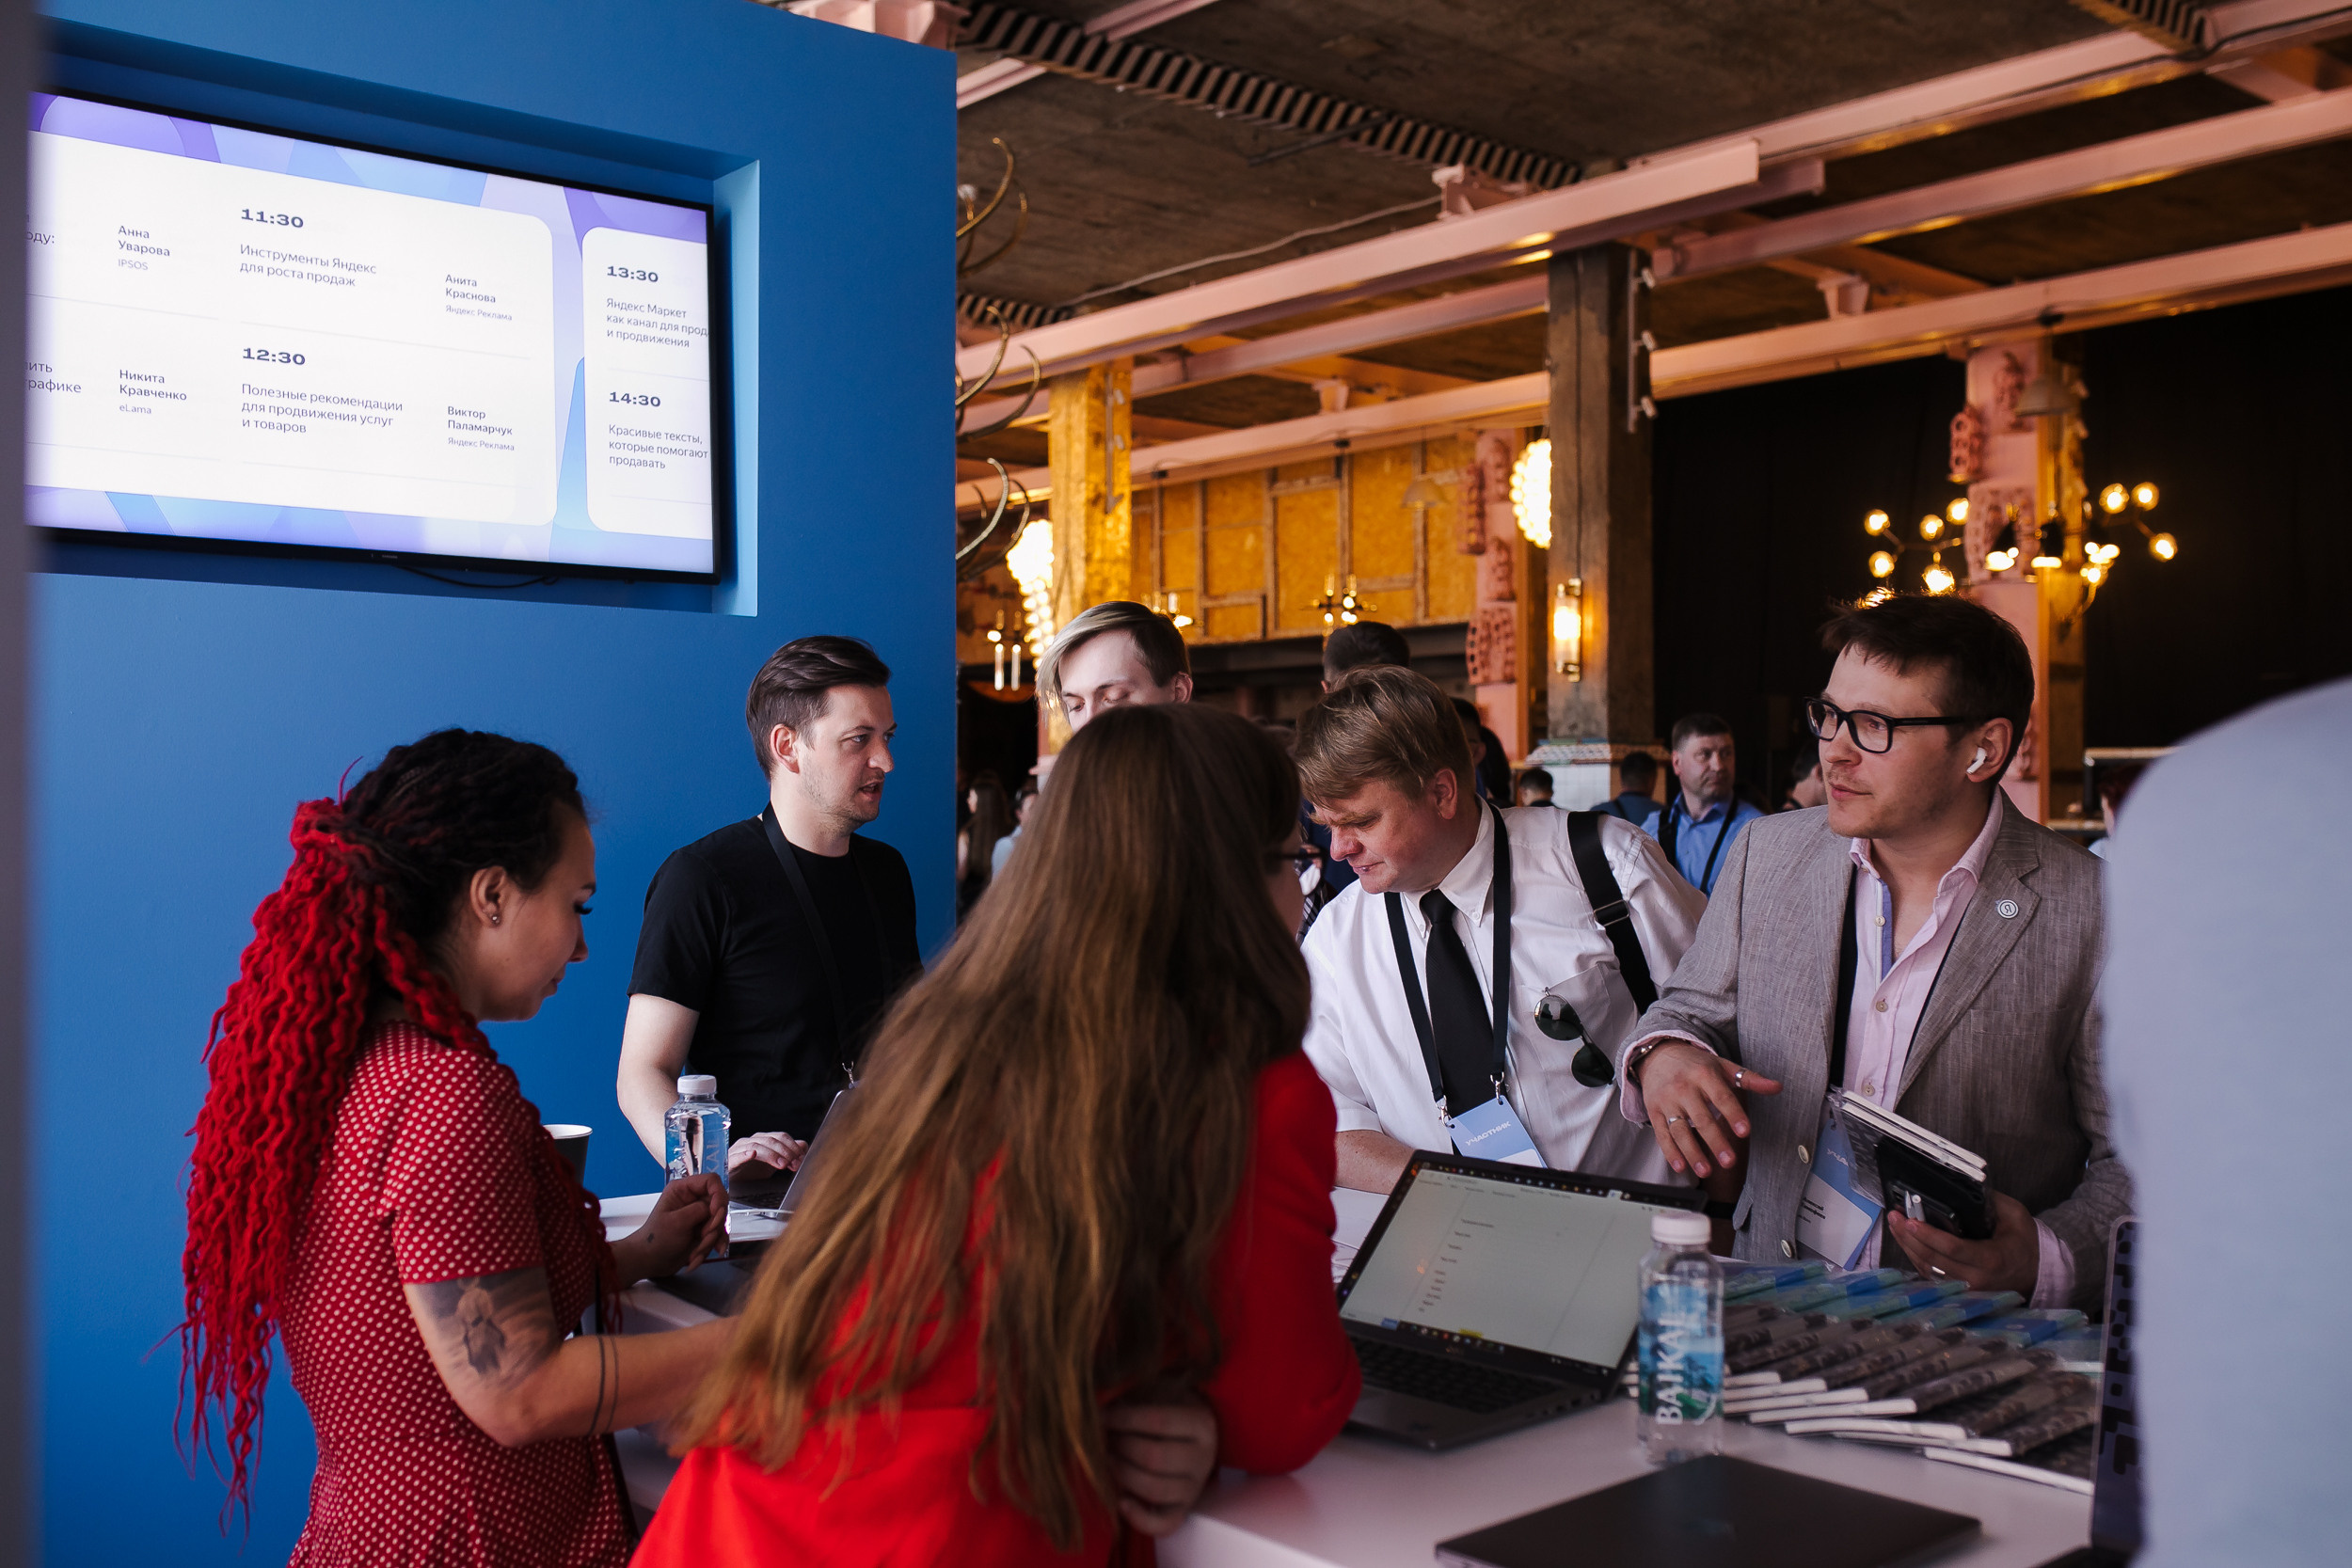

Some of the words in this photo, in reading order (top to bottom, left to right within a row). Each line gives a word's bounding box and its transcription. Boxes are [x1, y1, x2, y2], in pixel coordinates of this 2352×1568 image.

[241, 208, 305, 229] 11:30
[118, 225, 151, 239] Анна
[118, 240, 171, 257] Уварова
[118, 259, 149, 271] IPSOS
[240, 244, 330, 267] Инструменты
[332, 258, 377, 275] Яндекс
[240, 261, 264, 275] для
[267, 266, 304, 280] роста
[307, 271, 356, 286] продаж
[445, 274, 478, 287] Анита
[607, 265, 660, 283] 13:30
[445, 288, 497, 303] Краснова
[445, 305, 476, 318] Яндекс
[477, 309, 513, 322] Реклама
[606, 298, 645, 314] Яндекс
[647, 304, 687, 319] Маркет
[607, 314, 625, 325] как
[627, 316, 659, 329] канал
[660, 322, 679, 332] для
[607, 330, 614, 339] и
[616, 331, 691, 348] продвижения
[242, 347, 307, 366] 12:30
[25, 378, 82, 393] рафике
[119, 369, 166, 385] Никита
[119, 384, 188, 402] Кравченко
[242, 384, 308, 402] Полезные
[310, 392, 403, 411] рекомендации
[609, 391, 661, 408] 14:30
[119, 404, 152, 415] eLama
[242, 402, 265, 413] для
[268, 404, 358, 422] продвижения
[359, 412, 394, 428] услуг
[447, 405, 486, 420] Виктор
[242, 418, 251, 428] и
[253, 419, 307, 434] товаров
[447, 420, 514, 436] Паламарчук
[609, 424, 662, 439] Красивые
[664, 432, 703, 445] тексты,
[447, 437, 478, 450] Яндекс
[479, 441, 516, 451] Реклама
[609, 441, 655, 453] которые
[657, 446, 708, 459] помогают
[609, 456, 666, 469] продавать
[1466, 1121, 1512, 1146] УЧАСТНИК
[1656, 1310, 1685, 1425] BAIKAL
